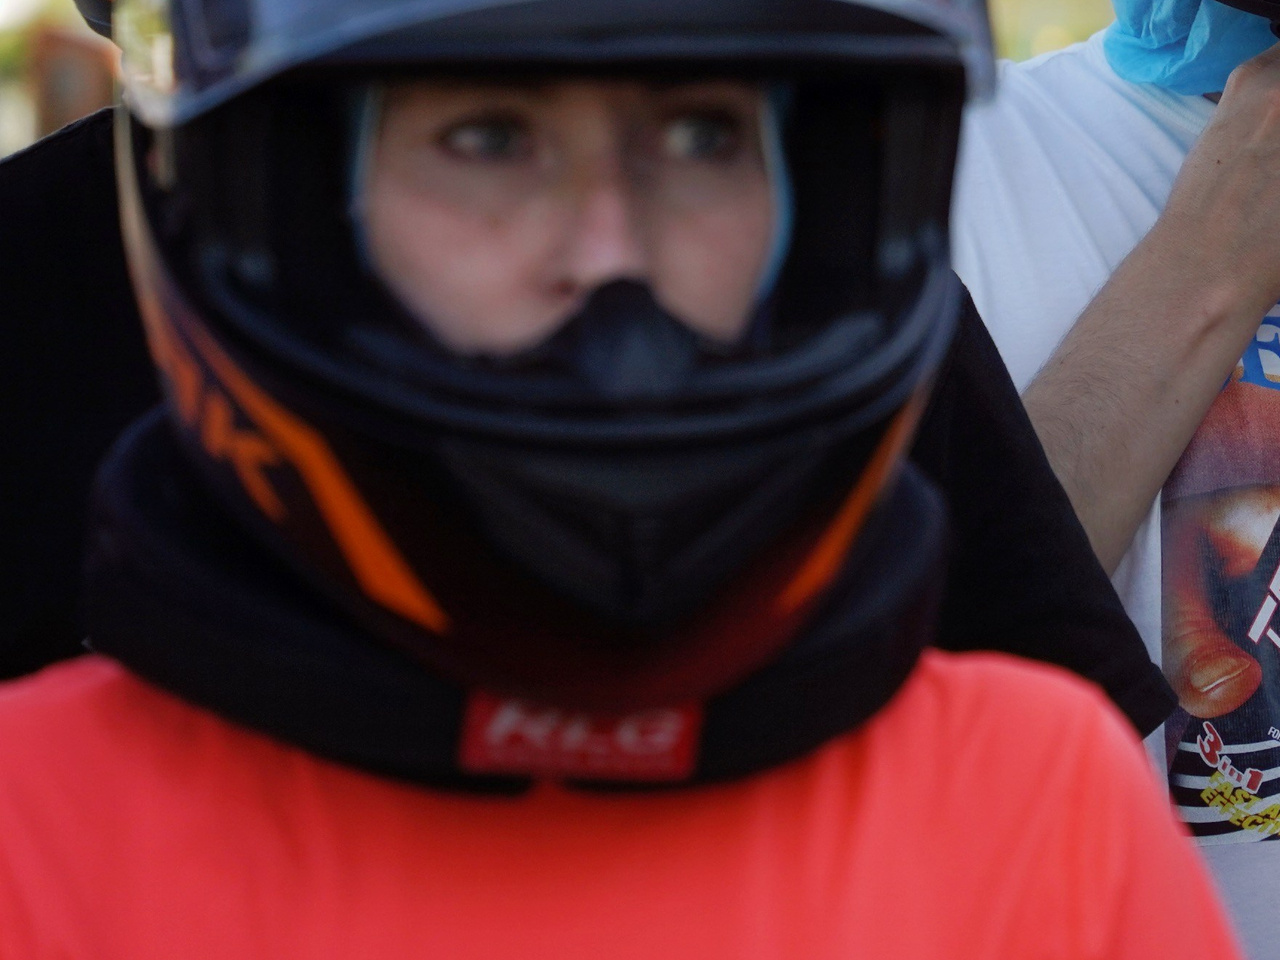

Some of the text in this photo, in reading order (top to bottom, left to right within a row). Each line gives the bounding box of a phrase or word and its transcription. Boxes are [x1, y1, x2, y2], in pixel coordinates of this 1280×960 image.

[1197, 719, 1264, 795] 3 in 1
